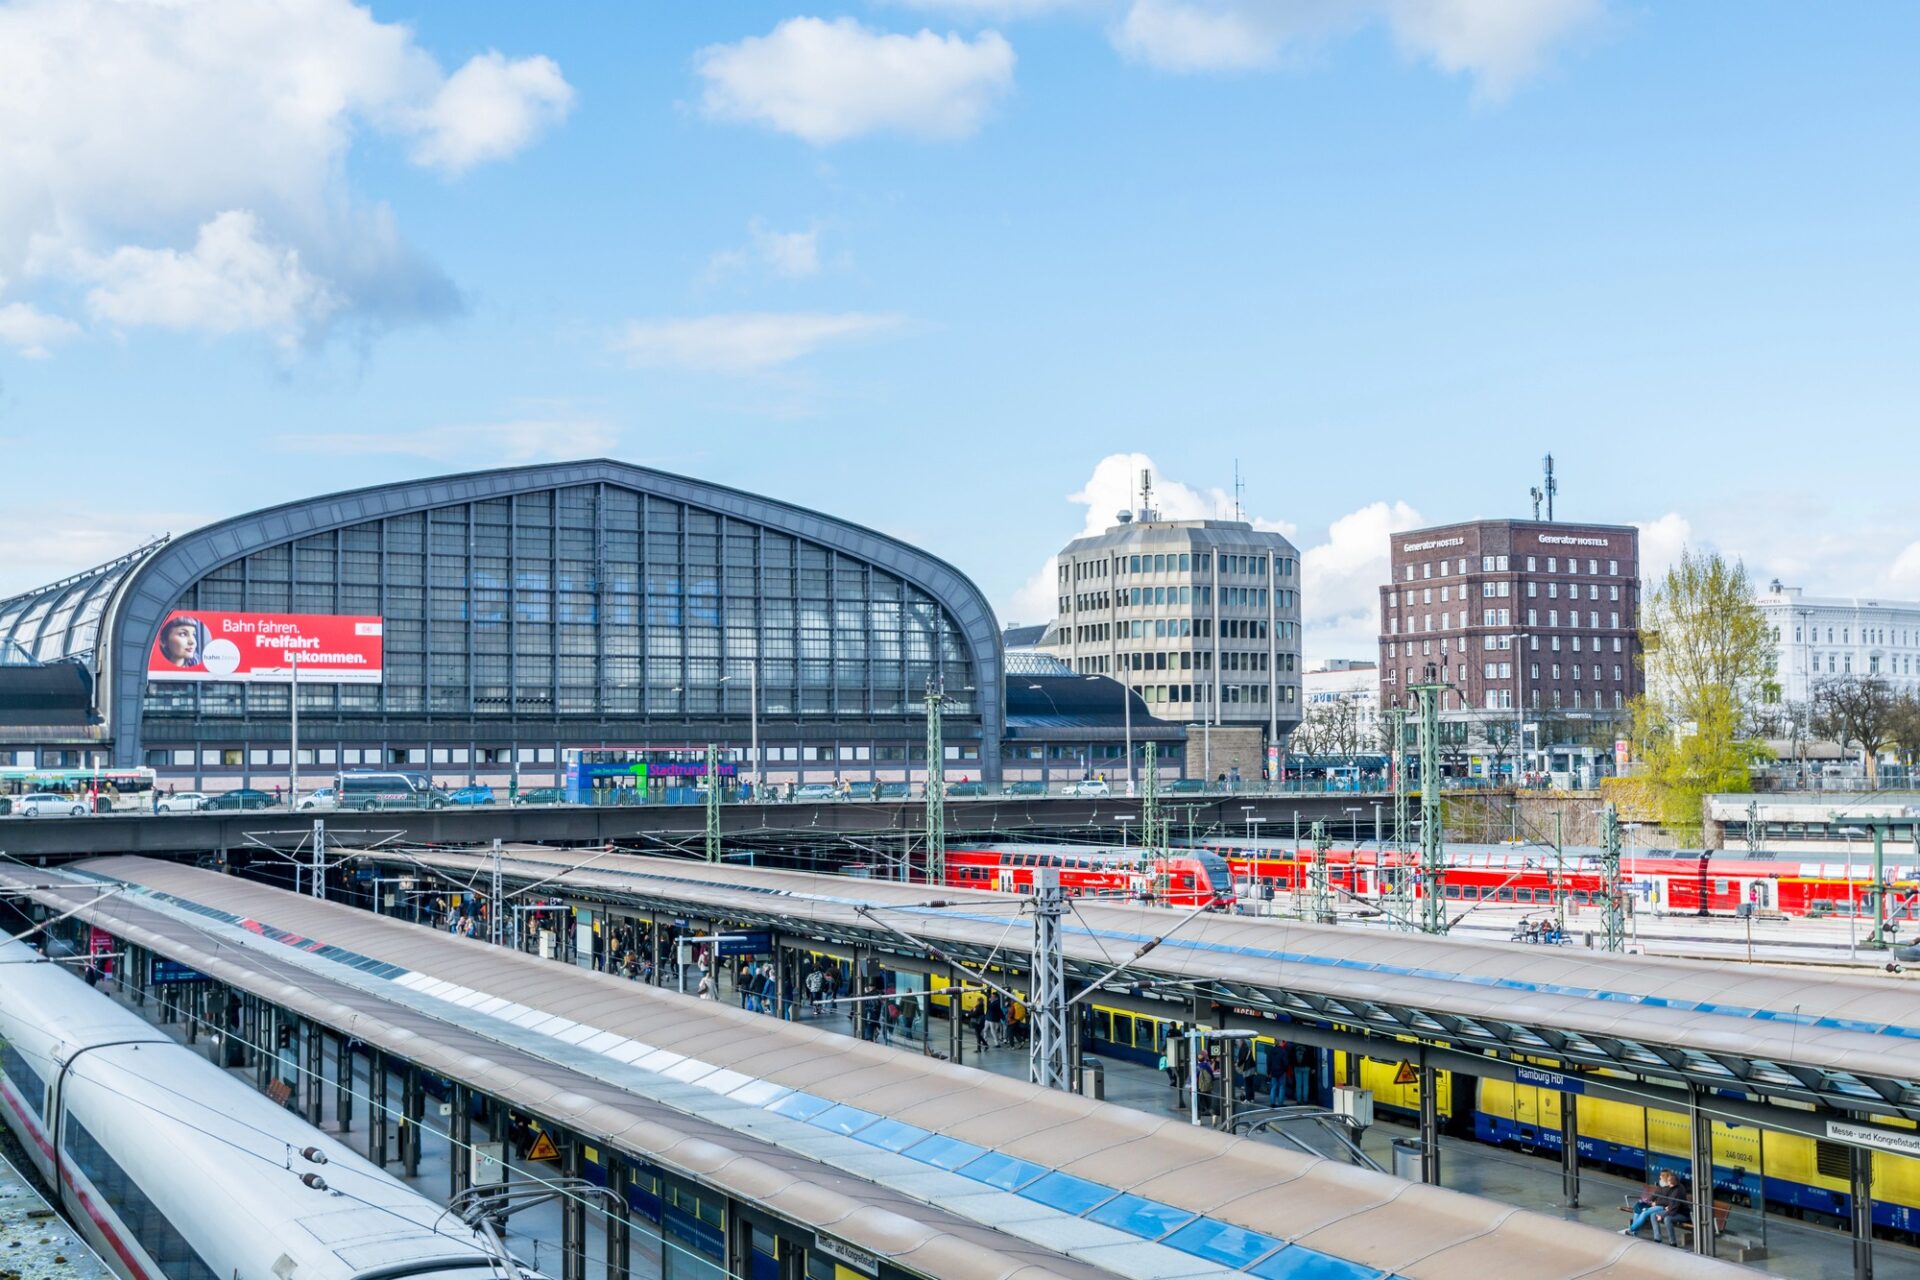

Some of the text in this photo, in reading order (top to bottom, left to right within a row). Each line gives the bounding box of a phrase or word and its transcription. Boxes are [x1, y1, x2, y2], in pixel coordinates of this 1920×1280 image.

[1404, 537, 1464, 552] Generator HOSTELS
[1539, 533, 1608, 547] Generator HOSTELS
[223, 619, 300, 634] Bahn fahren.
[255, 634, 320, 649] Freifahrt
[284, 650, 367, 664] bekommen.
[649, 763, 734, 776] Stadtrundhrt
[1518, 1067, 1550, 1084] Hamburg
[1831, 1125, 1920, 1149] Messe- und Kongreßstadt
